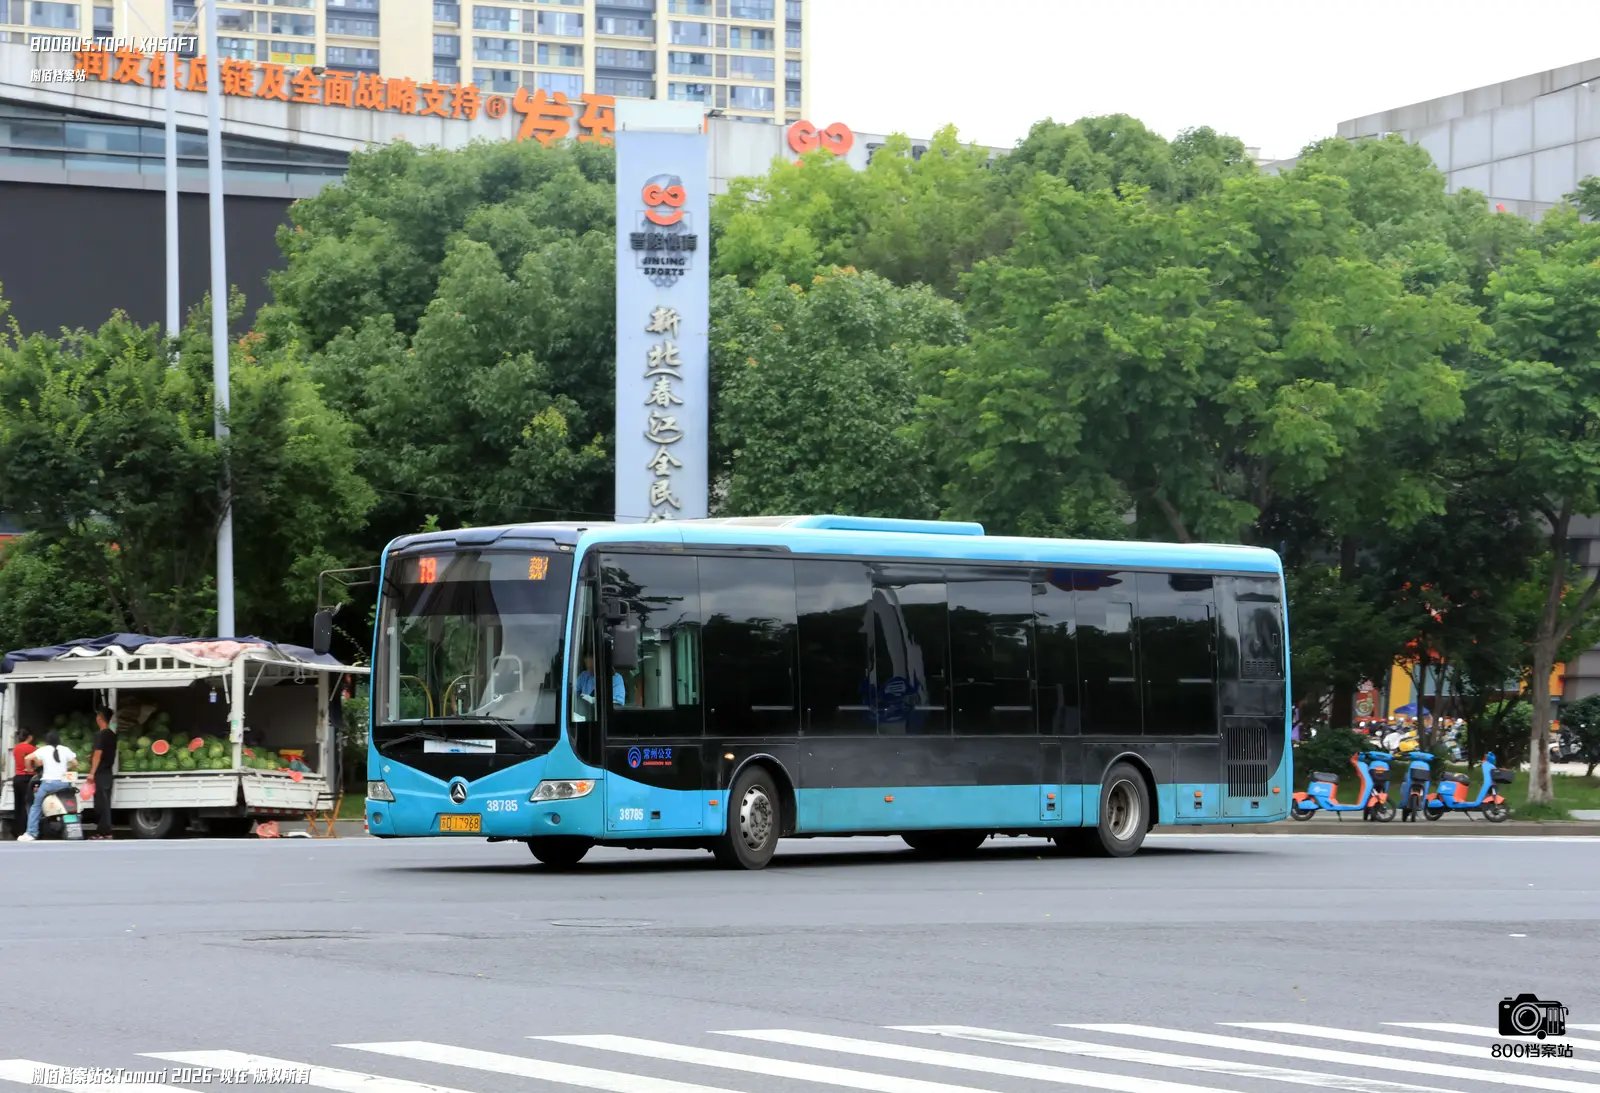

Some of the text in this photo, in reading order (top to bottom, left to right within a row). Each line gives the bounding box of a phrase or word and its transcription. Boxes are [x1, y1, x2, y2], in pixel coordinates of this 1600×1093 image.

[643, 257, 686, 266] JINLING
[643, 267, 685, 276] SPORTS
[643, 747, 673, 760] 常州公交
[486, 799, 518, 812] 38785
[619, 808, 644, 821] 38785
